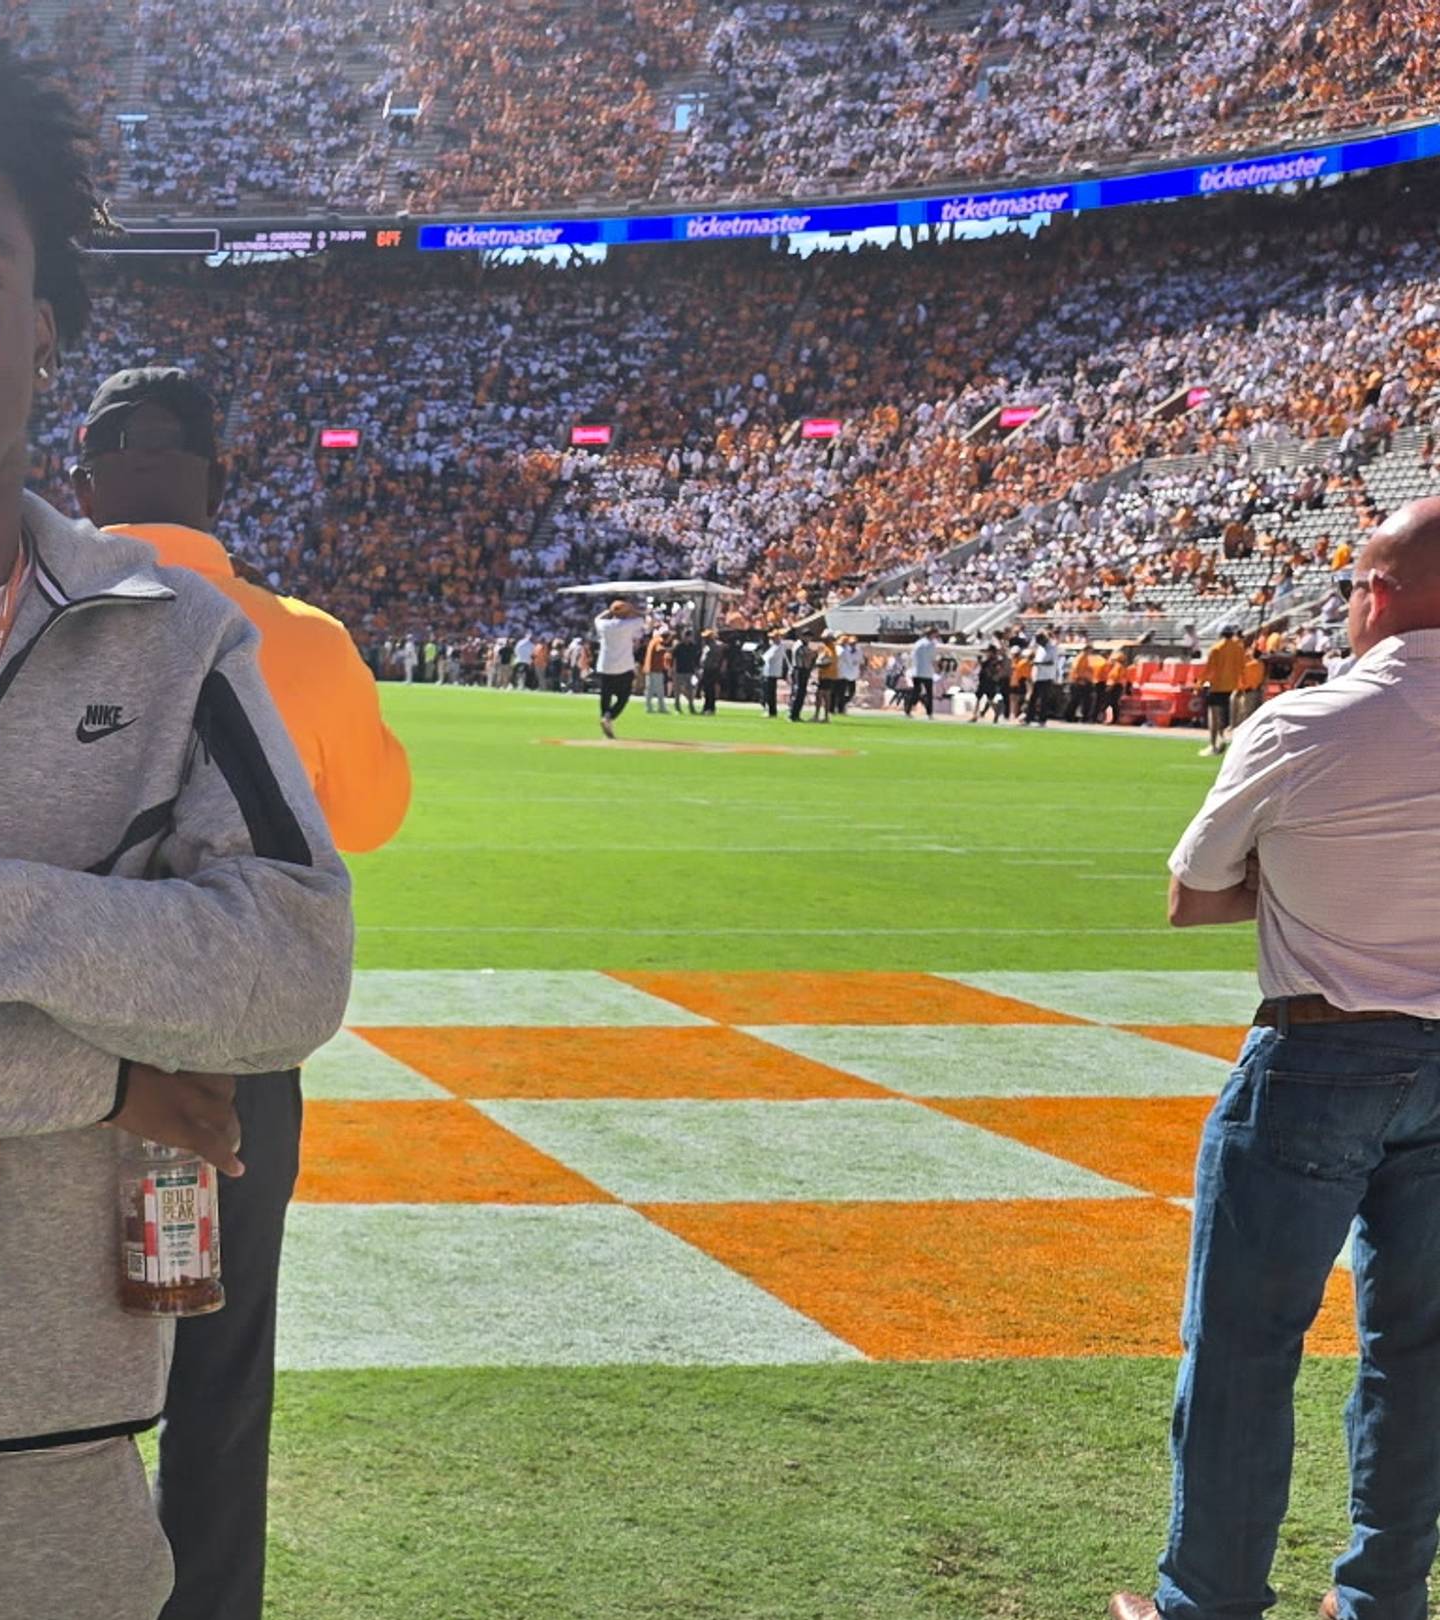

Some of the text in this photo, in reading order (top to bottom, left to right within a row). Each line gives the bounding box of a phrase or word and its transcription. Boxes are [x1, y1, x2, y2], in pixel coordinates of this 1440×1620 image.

[1200, 156, 1327, 190] ticketmaster
[941, 192, 1069, 220] ticketmaster
[445, 224, 563, 246] ticketmaster
[686, 214, 811, 238] ticketmaster
[85, 704, 124, 727] NIKE
[162, 1187, 195, 1205] GOLD
[162, 1202, 195, 1220] PEAK
